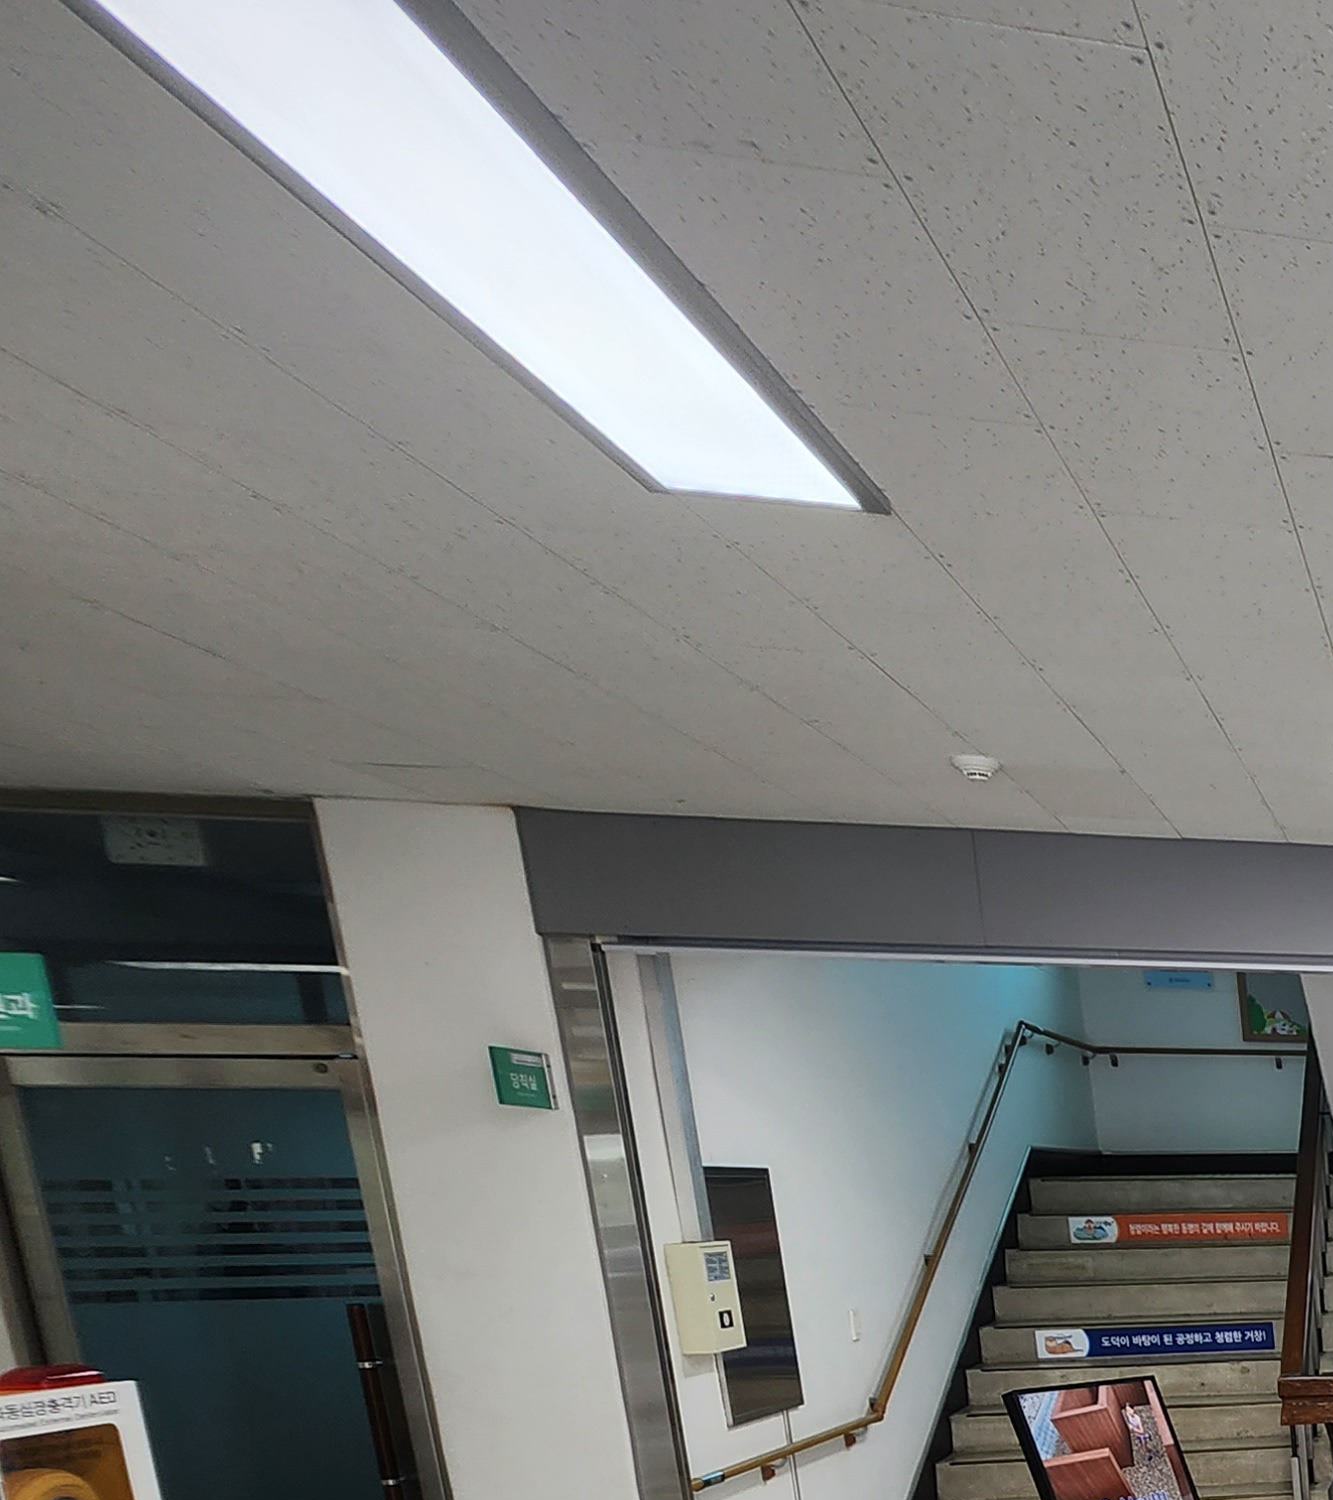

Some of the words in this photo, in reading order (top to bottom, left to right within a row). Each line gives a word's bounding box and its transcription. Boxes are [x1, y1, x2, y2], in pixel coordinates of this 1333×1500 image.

[510, 1072, 538, 1091] 당직실
[1101, 1333, 1130, 1348] 도덕이
[1132, 1333, 1160, 1347] 바탕이
[1163, 1332, 1174, 1346] 된
[1175, 1331, 1212, 1345] 공정하고
[1214, 1330, 1242, 1344] 청렴한
[1244, 1329, 1266, 1343] 거창!
[90, 1391, 117, 1407] AED
